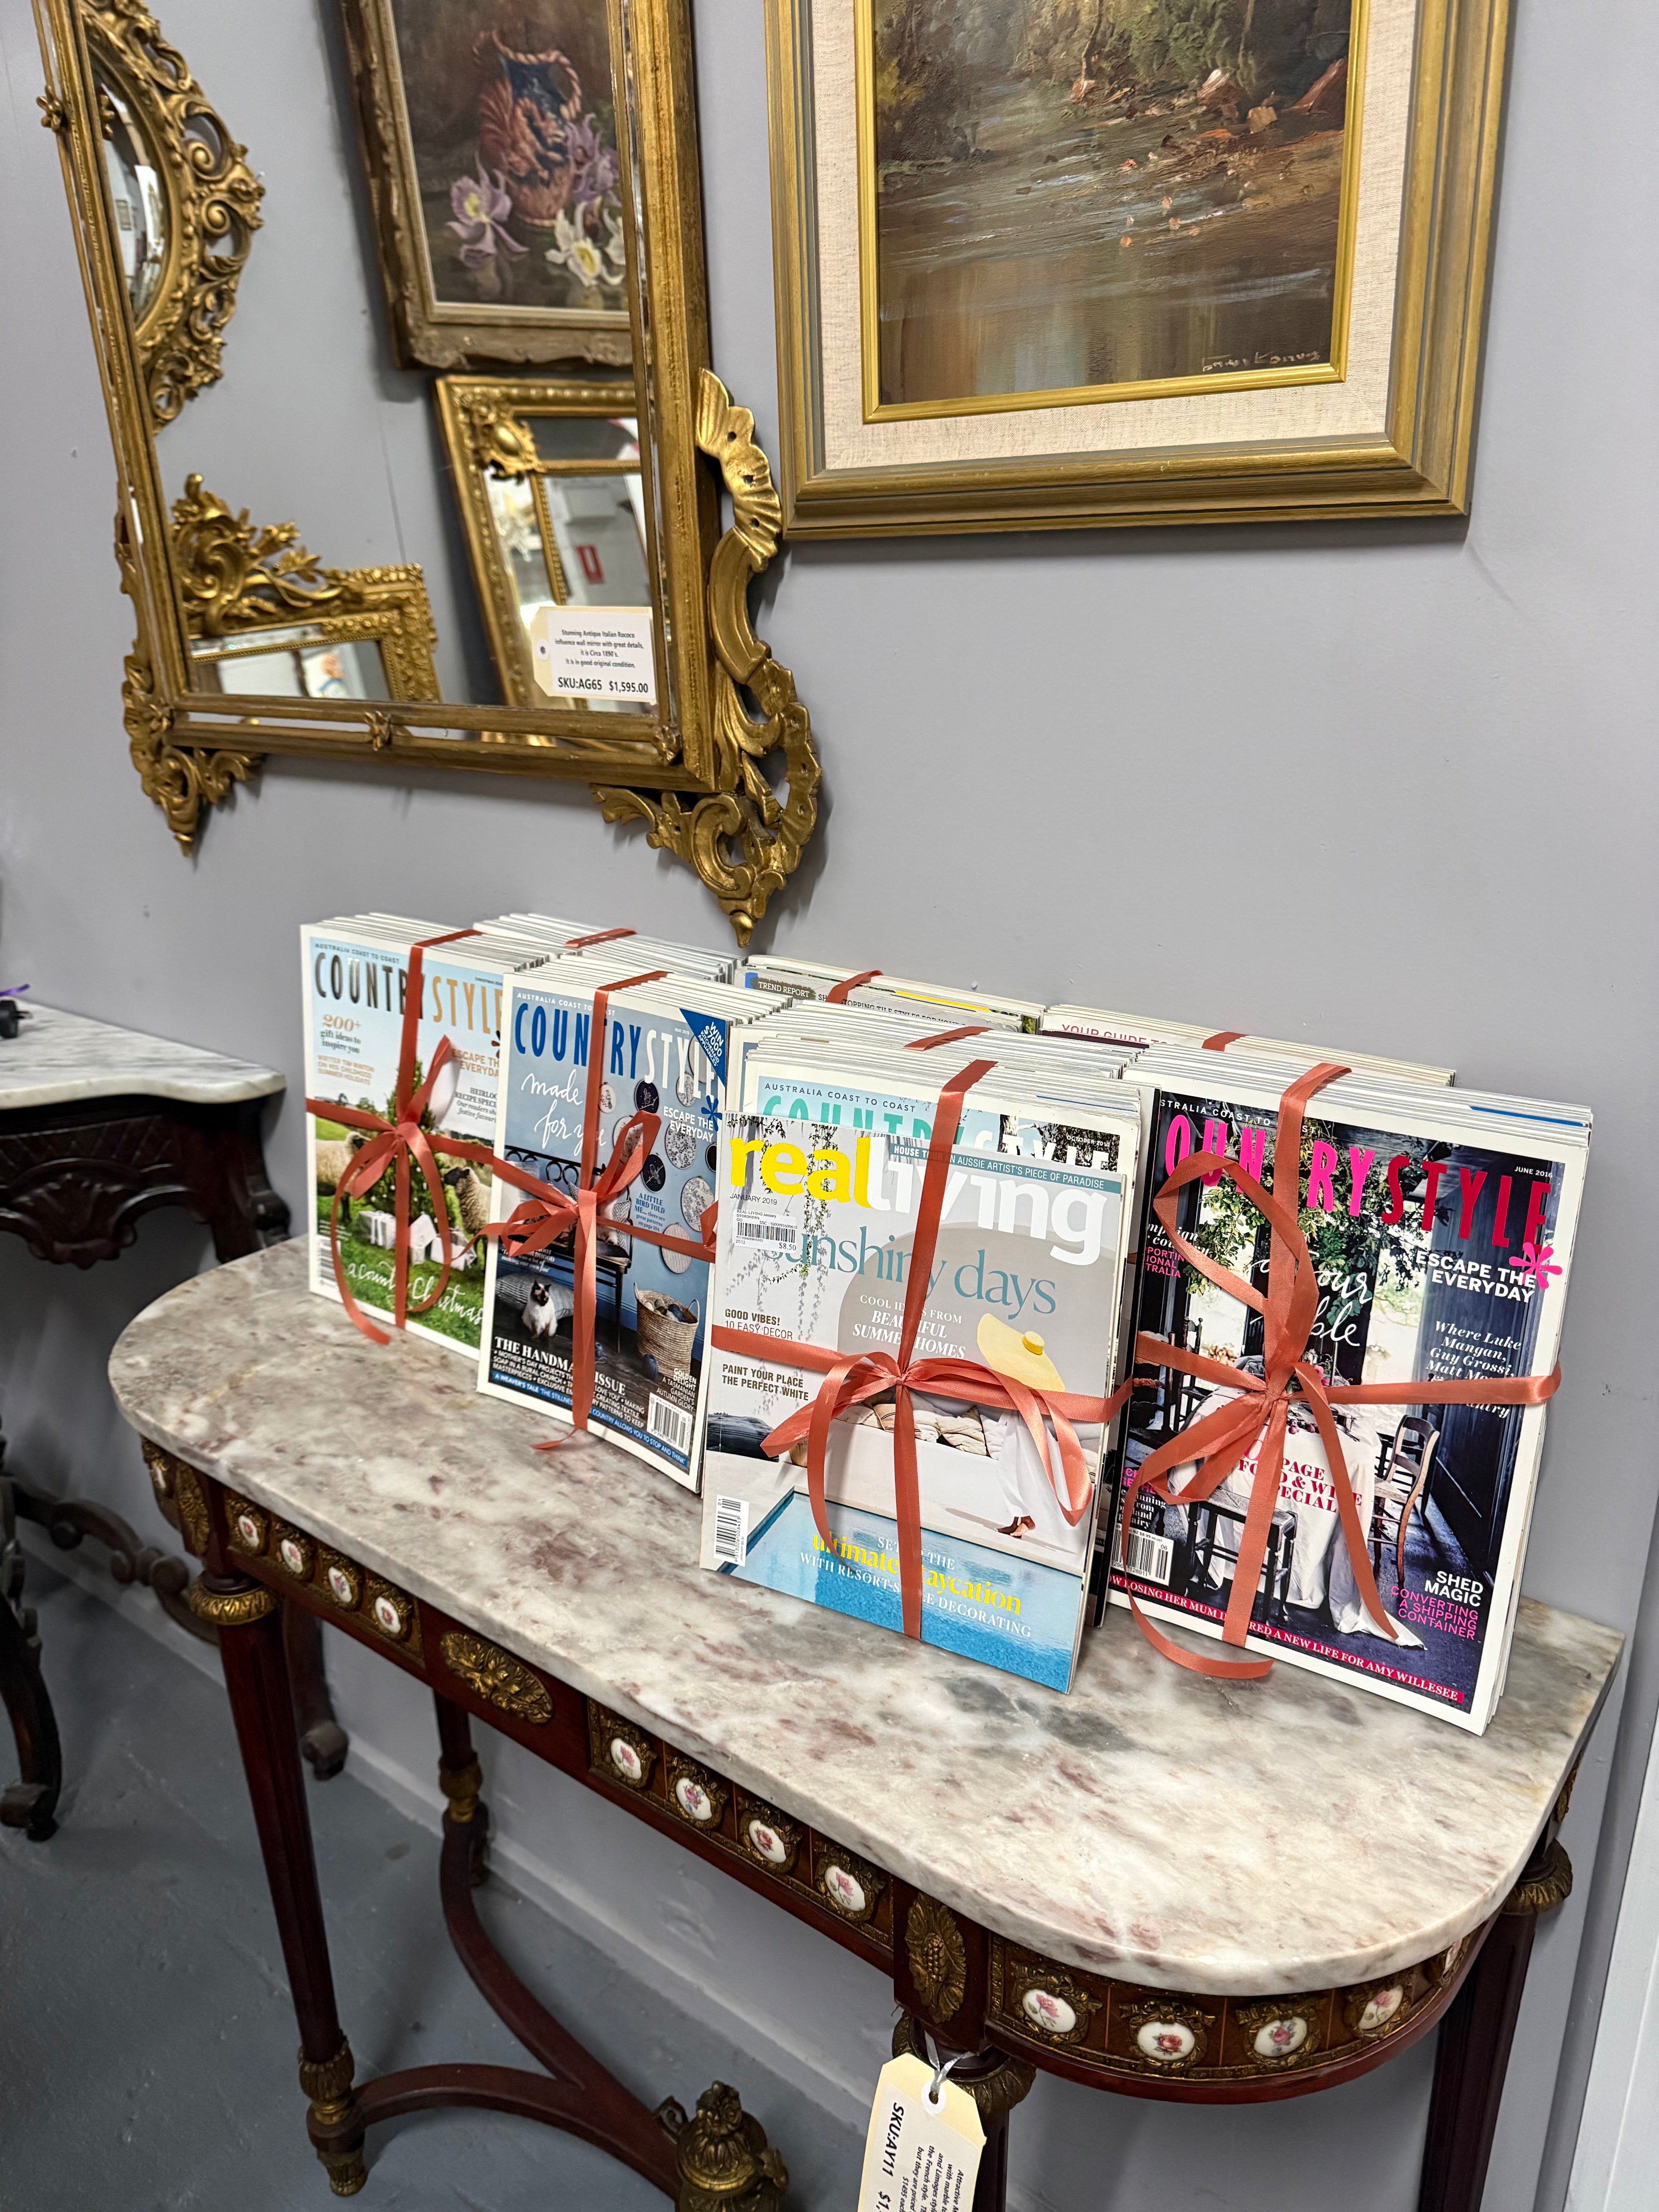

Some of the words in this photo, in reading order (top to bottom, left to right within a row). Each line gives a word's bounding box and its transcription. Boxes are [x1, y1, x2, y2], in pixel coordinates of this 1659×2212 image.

[558, 677, 602, 690] SKU:AG65
[609, 680, 648, 693] $1,595.00
[315, 943, 349, 953] AUSTRALIA
[380, 955, 400, 963] COAST
[314, 953, 425, 1020] COUNTR
[758, 982, 781, 992] TREND
[783, 986, 810, 998] REPORT
[517, 993, 555, 1004] AUSTRALIA
[559, 1000, 581, 1009] COAST
[515, 1003, 642, 1080] COUNRY
[701, 1030, 719, 1063] KITCHENAID
[710, 1022, 724, 1046] WIN
[460, 1061, 499, 1077] EVERYDA
[521, 1068, 583, 1106] made
[764, 1083, 823, 1097] AUSTRALIA
[828, 1091, 860, 1103] COAST
[865, 1097, 878, 1106] TO
[883, 1101, 916, 1113] COAST
[534, 1100, 572, 1149] for
[664, 1106, 695, 1125] ESCAPE
[697, 1116, 713, 1131] THE
[1212, 1108, 1250, 1121] COAST
[1256, 1116, 1271, 1126] TO
[670, 1120, 713, 1142] EVERYDAY
[1066, 1135, 1095, 1145] OCTOBER
[729, 1137, 872, 1209] real
[894, 1146, 919, 1157] HOUSE
[957, 1156, 985, 1168] AUSSIE
[987, 1162, 1023, 1175] ARTIST'S
[1025, 1168, 1048, 1180] PIECE
[1050, 1172, 1060, 1181] OF
[1063, 1174, 1104, 1189] PARADISE
[1514, 1165, 1533, 1176] JUNE
[1535, 1169, 1553, 1178] 2016
[730, 1193, 761, 1202] JANUARY
[1165, 1114, 1376, 1217] OUNRY
[1381, 1155, 1551, 1255] STYLE
[636, 1199, 649, 1208] BIRD
[651, 1204, 665, 1214] TOLD
[644, 1194, 663, 1206] LITTLE
[1415, 1250, 1492, 1278] ESCAPE
[1497, 1268, 1536, 1288] THE
[954, 1249, 1056, 1320] days
[1431, 1269, 1535, 1304] EVERYDAY
[725, 1309, 749, 1320] GOOD
[751, 1313, 780, 1326] VIBES!
[859, 1294, 892, 1309] COOL
[930, 1310, 962, 1324] FROM
[737, 1322, 760, 1333] EASY
[763, 1327, 793, 1340] DECOR
[871, 1310, 948, 1338] BEAUIFUL
[1436, 1321, 1481, 1340] Where
[1483, 1333, 1522, 1350] Luke
[853, 1323, 902, 1345] SUMME
[914, 1338, 966, 1359] HOMES
[1441, 1336, 1506, 1363] Mangan,
[495, 1336, 521, 1354] THE
[522, 1345, 573, 1372] HANDMA
[594, 1371, 626, 1396] ISSUE
[1425, 1360, 1463, 1377] Matt
[1430, 1348, 1460, 1365] Guy
[1463, 1355, 1514, 1377] Grossi,
[668, 1379, 695, 1398] TASMANIAN
[673, 1375, 696, 1391] DELIGHT
[674, 1368, 696, 1384] GOLDEN
[721, 1375, 739, 1386] THE
[741, 1379, 779, 1395] PERFECT
[781, 1386, 809, 1401] WHITE
[722, 1364, 748, 1376] PAINT
[751, 1369, 774, 1382] YOUR
[776, 1374, 804, 1388] PLACE
[537, 1377, 565, 1393] EXCLUSIVE
[599, 1402, 623, 1418] PATTERNS
[632, 1418, 644, 1428] KEEP
[596, 1393, 620, 1409] CREATING
[621, 1404, 639, 1419] TEXTILE
[624, 1398, 644, 1414] MAKING
[656, 1388, 677, 1403] AUTUMN
[678, 1399, 694, 1412] GLORY
[671, 1388, 694, 1405] GARDEN'S
[592, 1408, 614, 1424] COUNTRY
[614, 1418, 633, 1434] ALLOWS
[633, 1427, 643, 1439] YOU
[644, 1433, 649, 1443] TO
[650, 1437, 661, 1449] STOP
[661, 1445, 672, 1456] AND
[1292, 1476, 1306, 1489] &
[927, 1551, 956, 1570] THE
[800, 1553, 835, 1571] WITH
[938, 1598, 1032, 1638] DECORATING
[922, 1566, 1021, 1614] aycation
[1425, 1580, 1481, 1607] MAGIC
[1436, 1570, 1484, 1595] SHED
[1391, 1585, 1478, 1621] CONVERTING
[1400, 1599, 1408, 1609] A
[1413, 1604, 1477, 1631] SHIPPING
[1398, 1608, 1475, 1640] CONTAINER
[1164, 1594, 1187, 1608] HER
[1189, 1602, 1219, 1618] MUM
[1284, 1632, 1312, 1647] NEW
[1312, 1642, 1338, 1659] LIFE
[1341, 1652, 1366, 1669] FOR
[1367, 1662, 1395, 1678] AMY
[1396, 1671, 1458, 1701] WILLESEE
[882, 2102, 904, 2177] SKU:AY11
[916, 2147, 924, 2161] but
[912, 2161, 921, 2176] they
[924, 2159, 933, 2183] French
[932, 2168, 942, 2196] Limoges
[953, 2169, 963, 2207] Attractive
